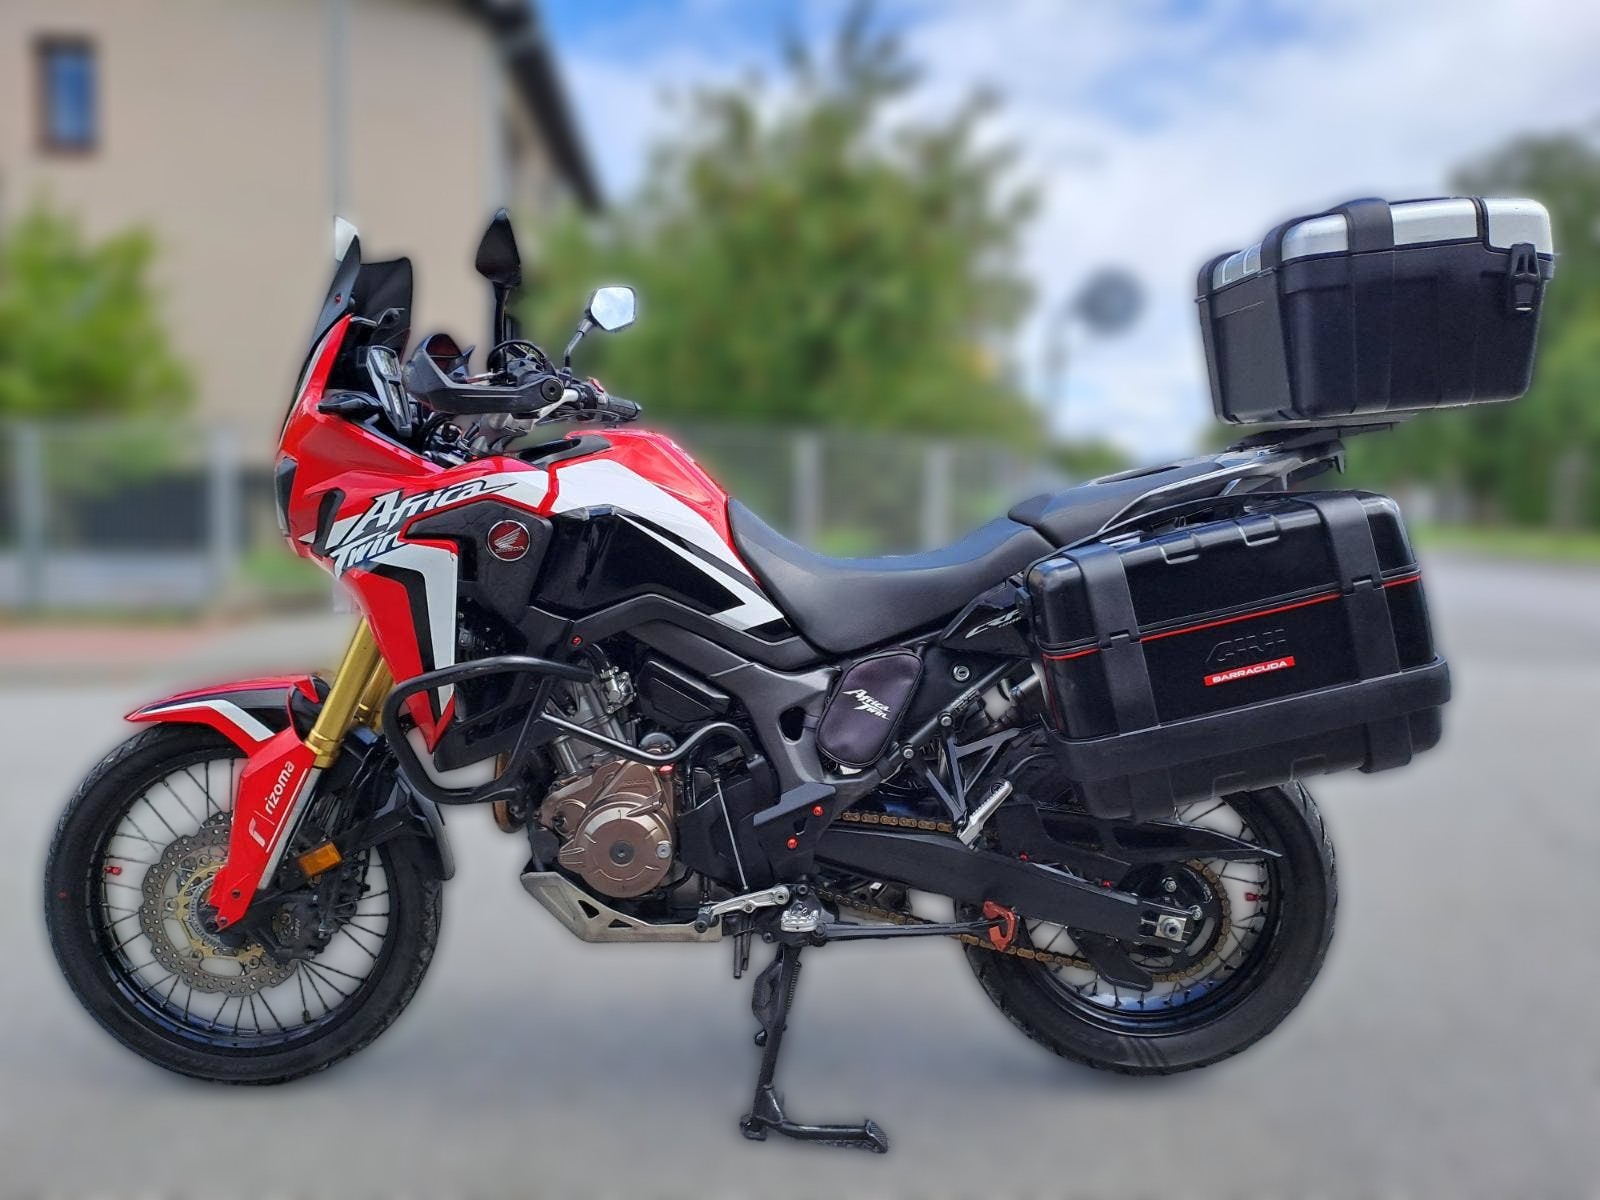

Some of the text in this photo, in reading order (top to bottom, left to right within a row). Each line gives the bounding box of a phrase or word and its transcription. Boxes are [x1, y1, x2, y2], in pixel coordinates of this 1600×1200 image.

[340, 480, 518, 546] Africa
[330, 531, 410, 580] Twin
[1211, 660, 1288, 684] BARRACUDA
[842, 688, 891, 712] Africa
[264, 760, 296, 816] rizoma
